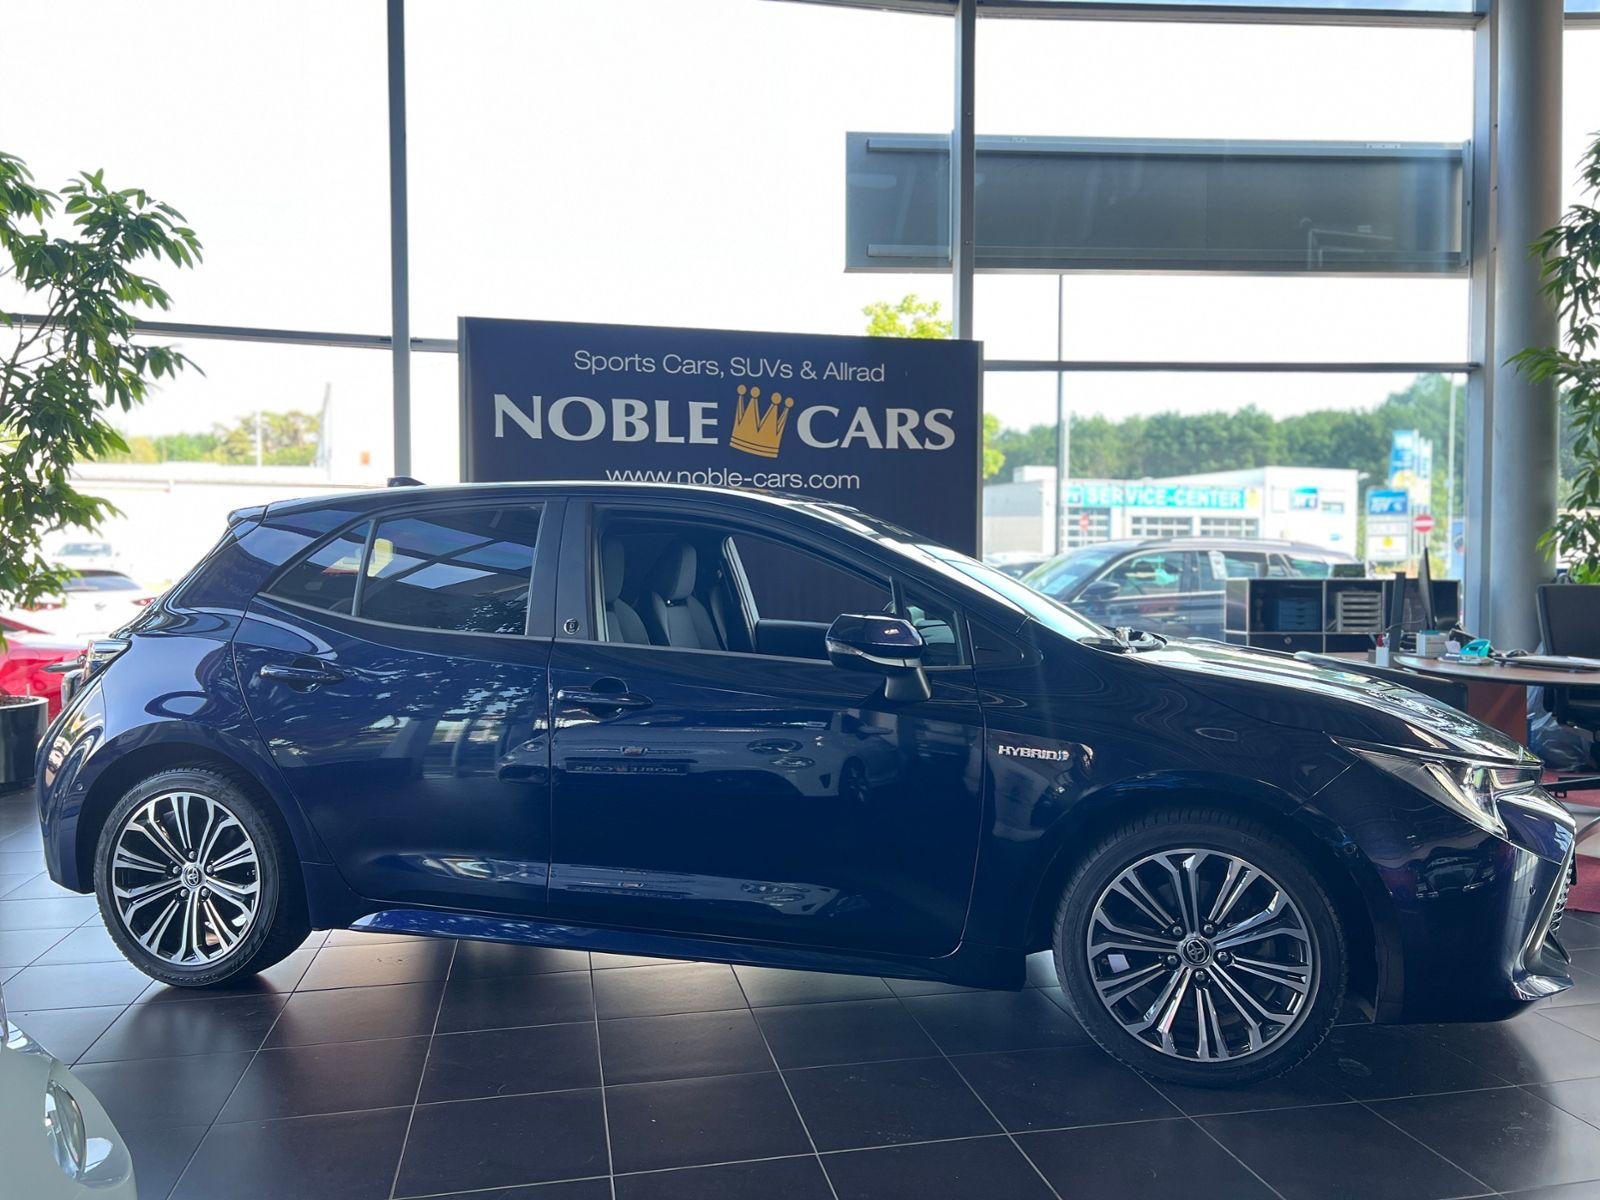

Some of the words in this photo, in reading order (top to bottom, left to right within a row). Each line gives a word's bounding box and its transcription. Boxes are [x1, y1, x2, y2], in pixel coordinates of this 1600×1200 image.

[574, 350, 656, 375] Sports
[662, 353, 725, 379] Cars,
[730, 356, 793, 379] SUVs
[800, 361, 818, 380] &
[823, 361, 886, 382] Allrad
[494, 393, 719, 445] NOBLE
[797, 405, 955, 451] CARS
[605, 467, 861, 489] wwwnoble-cars.com
[1086, 485, 1241, 507] SERVICE-CENTER
[997, 745, 1057, 760] HYBRID
